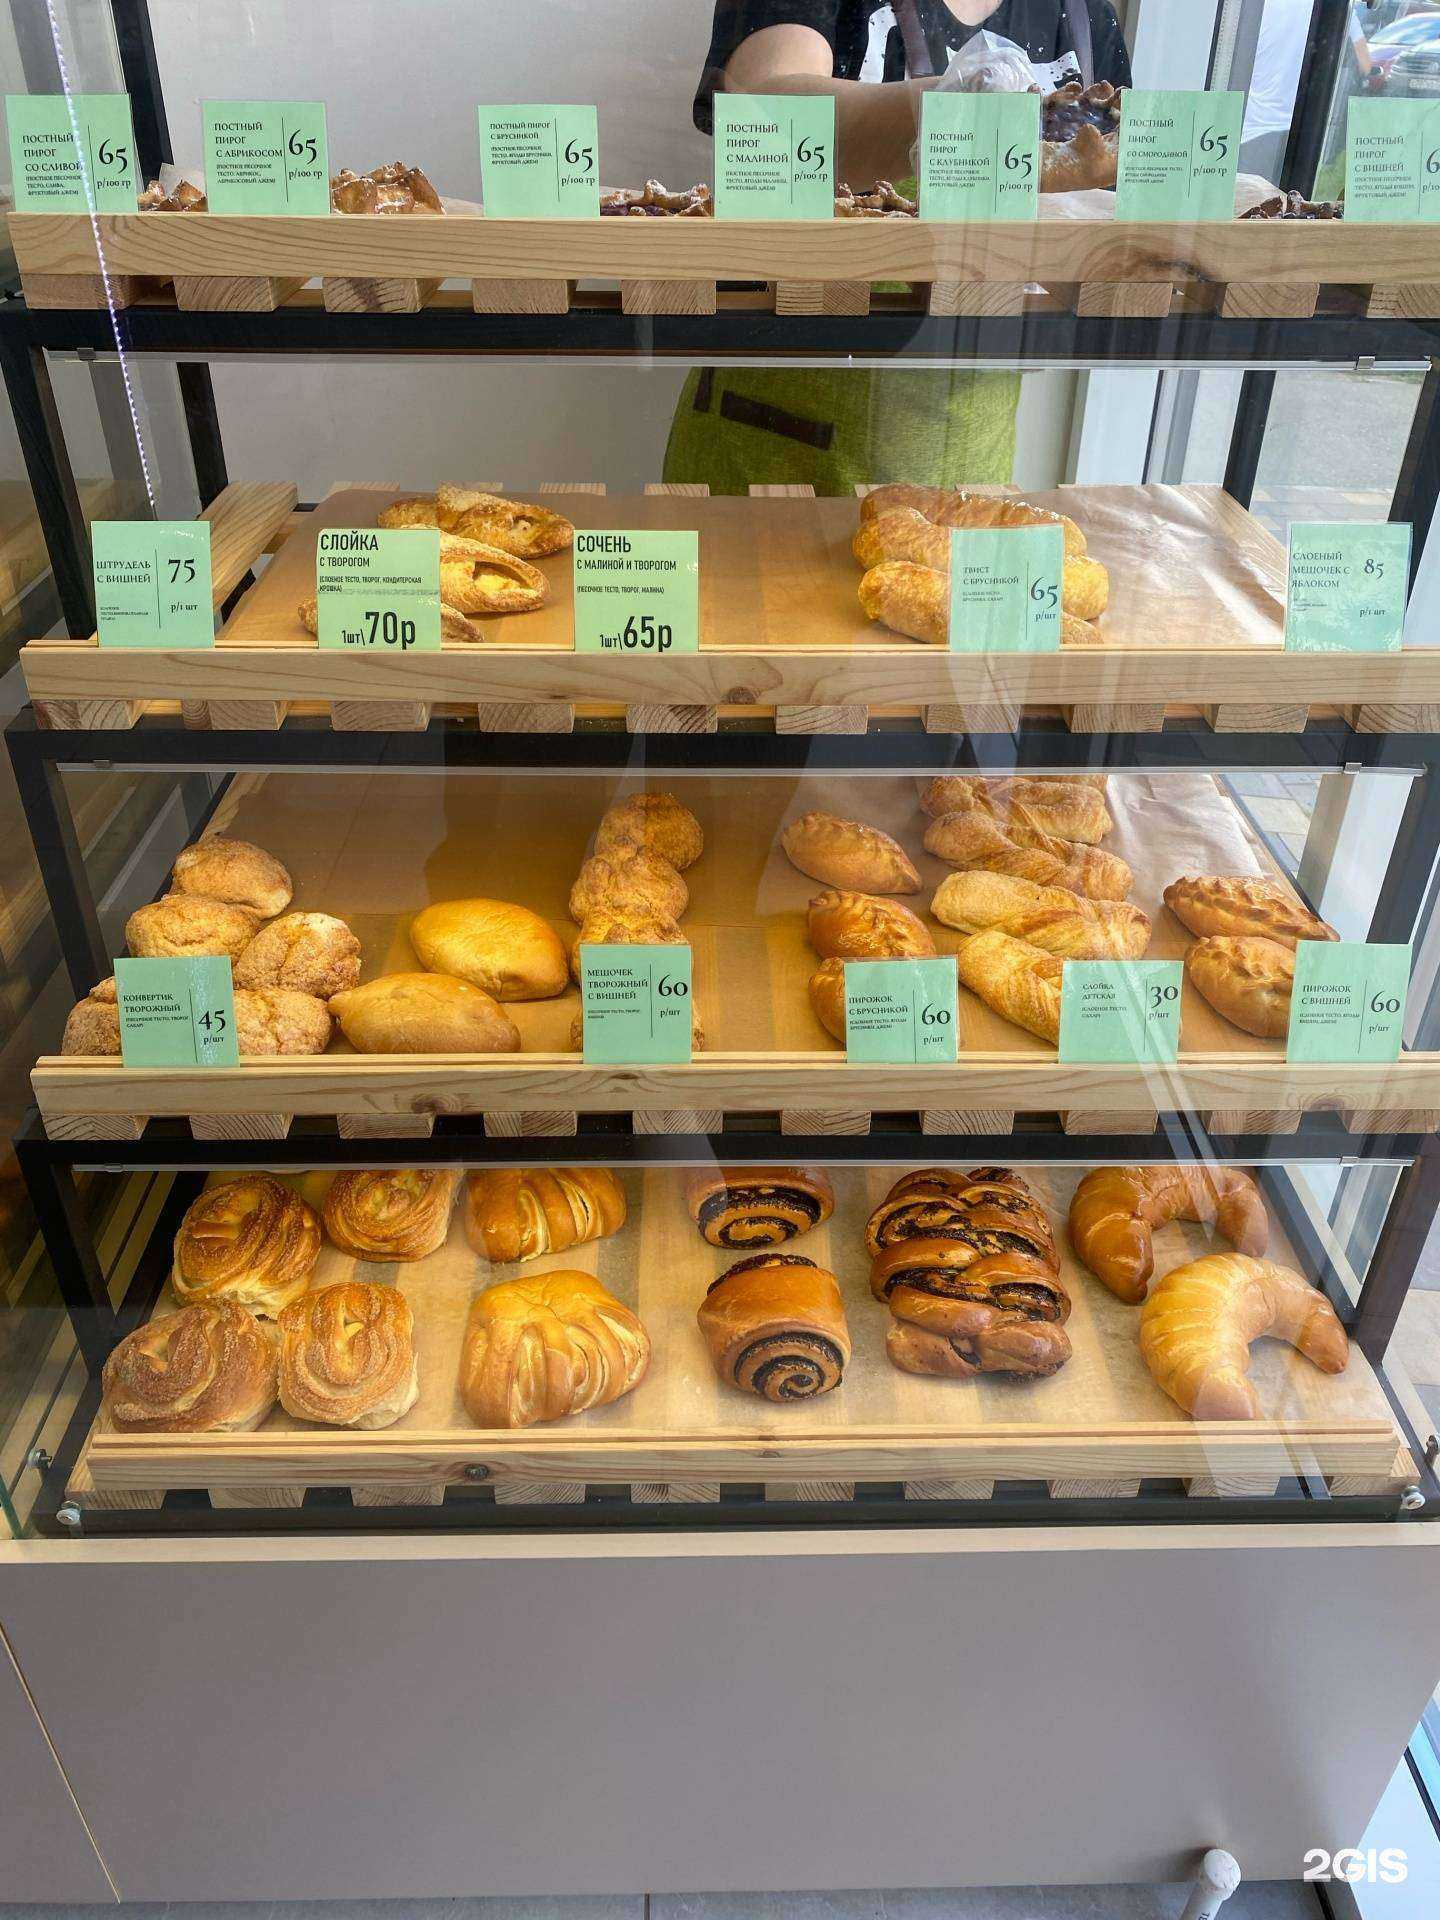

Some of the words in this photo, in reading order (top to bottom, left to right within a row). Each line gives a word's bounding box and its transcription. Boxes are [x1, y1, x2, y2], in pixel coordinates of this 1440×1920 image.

[215, 122, 262, 130] ПОСТНЫЙ
[727, 124, 778, 133] ПОСТНЫЙ
[1129, 119, 1174, 128] ПОСТНЫЙ
[23, 133, 74, 143] ПОСТНЫЙ
[930, 133, 974, 141] ПОСТНЫЙ
[1355, 136, 1404, 145] ПОСТНЫЙ
[289, 129, 317, 165] 65
[727, 140, 760, 148] ПИРОГ
[1200, 125, 1228, 162] 65
[24, 149, 56, 157] ПИРОГ
[99, 139, 127, 173] 65
[565, 139, 593, 173] 65
[736, 153, 788, 163] МАЛИНОЙ
[797, 137, 824, 171] 65
[42, 160, 83, 171] СЛИВОЙ
[937, 158, 990, 166] КЛУБНИКОЙ
[1005, 144, 1032, 179] 65
[1194, 165, 1215, 177] р/100
[1218, 168, 1227, 177] гр
[1363, 163, 1404, 172] ВИШНЕЙ
[289, 168, 311, 180] р/100
[314, 170, 322, 179] гр
[794, 171, 816, 183] р/100
[819, 173, 827, 182] гр
[97, 178, 119, 189] р/100
[121, 181, 131, 189] гр
[562, 175, 583, 187] р/100
[586, 178, 595, 187] гр
[1000, 182, 1021, 192] р/100
[1023, 184, 1032, 192] гр
[321, 531, 378, 551] СЛОЙКА
[577, 536, 631, 553] СОЧЕНЬ
[1293, 551, 1343, 560] СЛОЕНЫЙ
[97, 561, 151, 569] ШТРУДЕЛЬ
[320, 557, 325, 566] С
[328, 557, 370, 567] ТВОРОГОМ
[577, 560, 582, 569] С
[585, 558, 624, 570] МАЛИНОЙ
[626, 561, 632, 570] И
[635, 560, 676, 570] ТВОРОГОМ
[168, 558, 196, 584] 75
[1292, 566, 1341, 574] МЕШОЧЕК
[1364, 558, 1384, 579] 85
[97, 575, 104, 583] С
[106, 574, 150, 583] ВИШНЕЙ
[970, 576, 1019, 585] БРУСНИКОЙ
[1291, 580, 1339, 588] ЯБЛОКОМ
[1031, 576, 1058, 609] 65
[1035, 610, 1057, 622] р/шт
[589, 979, 648, 989] ТВОРОЖНЫЙ
[659, 974, 688, 997] 60
[1303, 985, 1352, 993] ПИРОЖОК
[123, 994, 174, 1002] КОНВЕРТИК
[597, 991, 636, 1000] ВИШНЕЙ
[849, 996, 893, 1004] ПИРОЖОК
[1150, 986, 1178, 1009] 30
[1310, 997, 1351, 1005] ВИШНЕЙ
[1371, 990, 1400, 1013] 60
[125, 1004, 181, 1013] ТВОРОЖНЫЙ
[660, 1008, 681, 1018] р/шт
[857, 1005, 908, 1015] БРУСНИКОЙ
[922, 1003, 951, 1025] 60
[1149, 1012, 1169, 1020] р/шт
[199, 1010, 226, 1033] 45
[1369, 1023, 1390, 1034] р/шт
[203, 1034, 224, 1045] р/шт
[923, 1035, 944, 1045] р/шт
